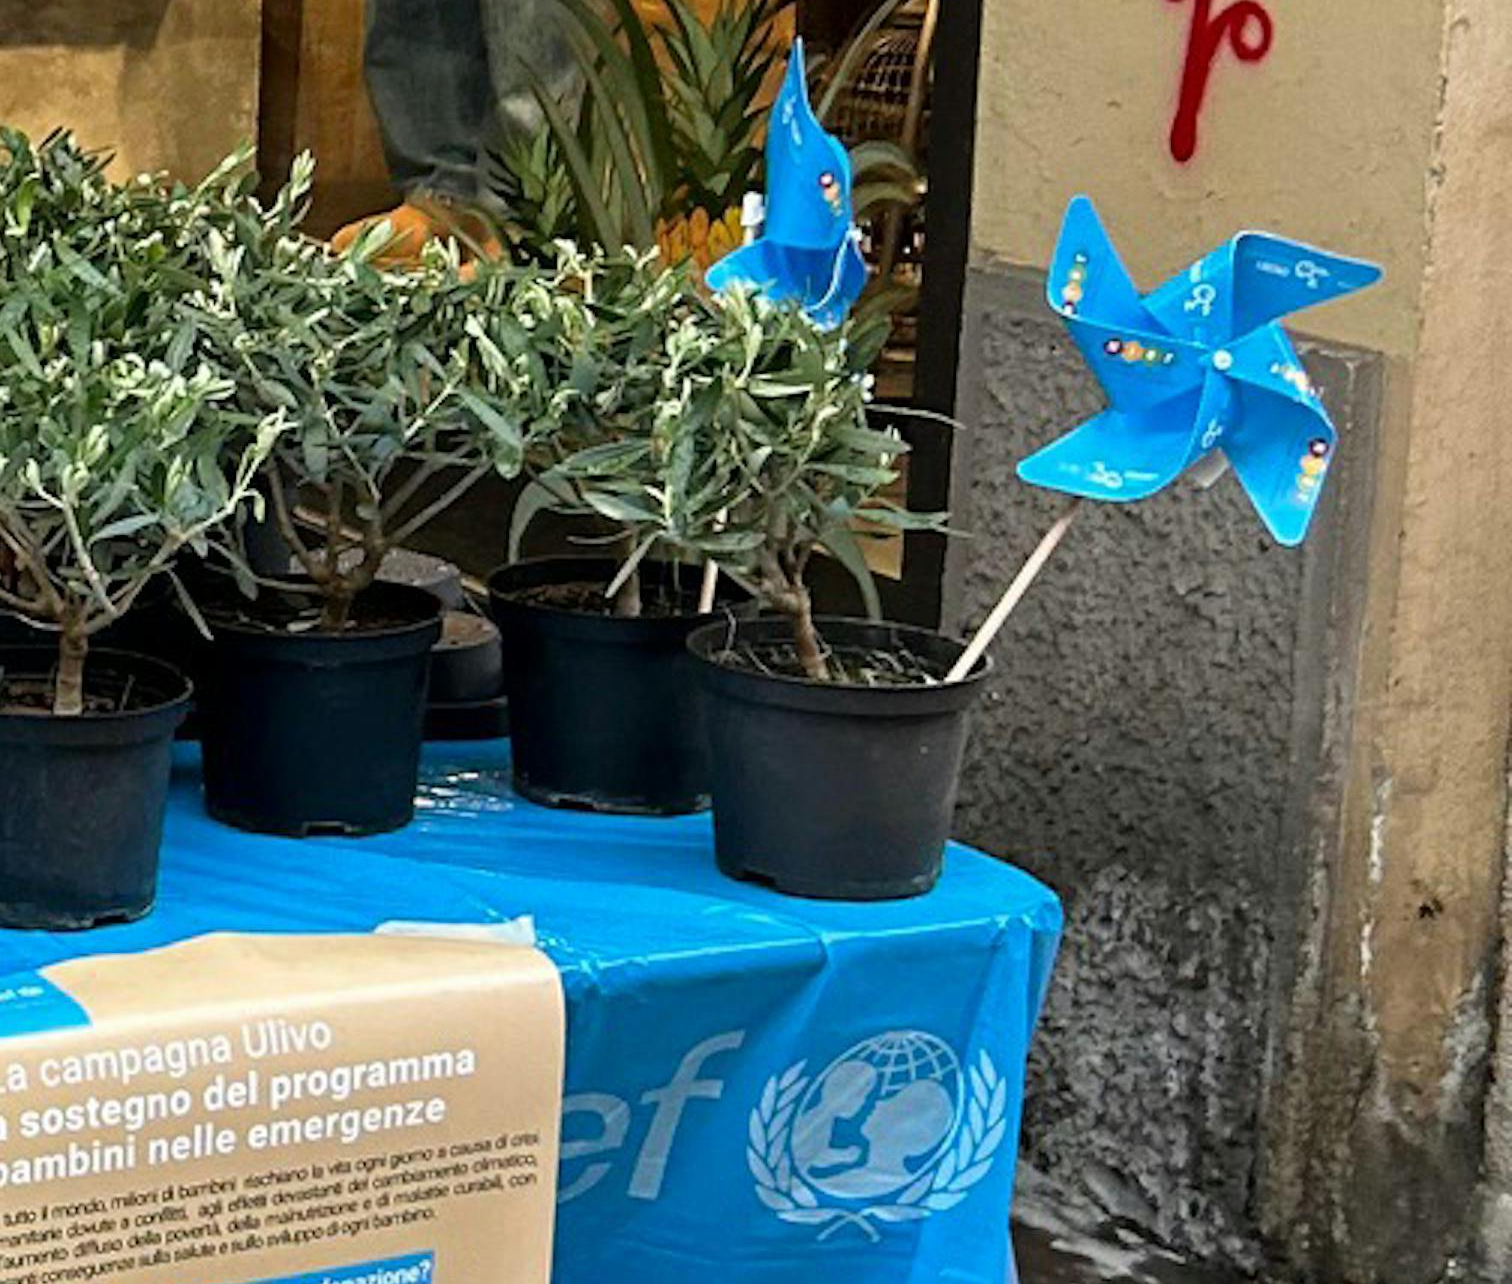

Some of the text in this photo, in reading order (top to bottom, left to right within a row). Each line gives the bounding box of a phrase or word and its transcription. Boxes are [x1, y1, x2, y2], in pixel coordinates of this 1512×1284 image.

[39, 1035, 231, 1087] campagna
[239, 1017, 332, 1059] Ulivo
[19, 1088, 191, 1138] sostegno
[203, 1068, 258, 1112] del
[270, 1048, 474, 1112] programma
[148, 1120, 236, 1166] nelle
[247, 1095, 445, 1151] emergenze
